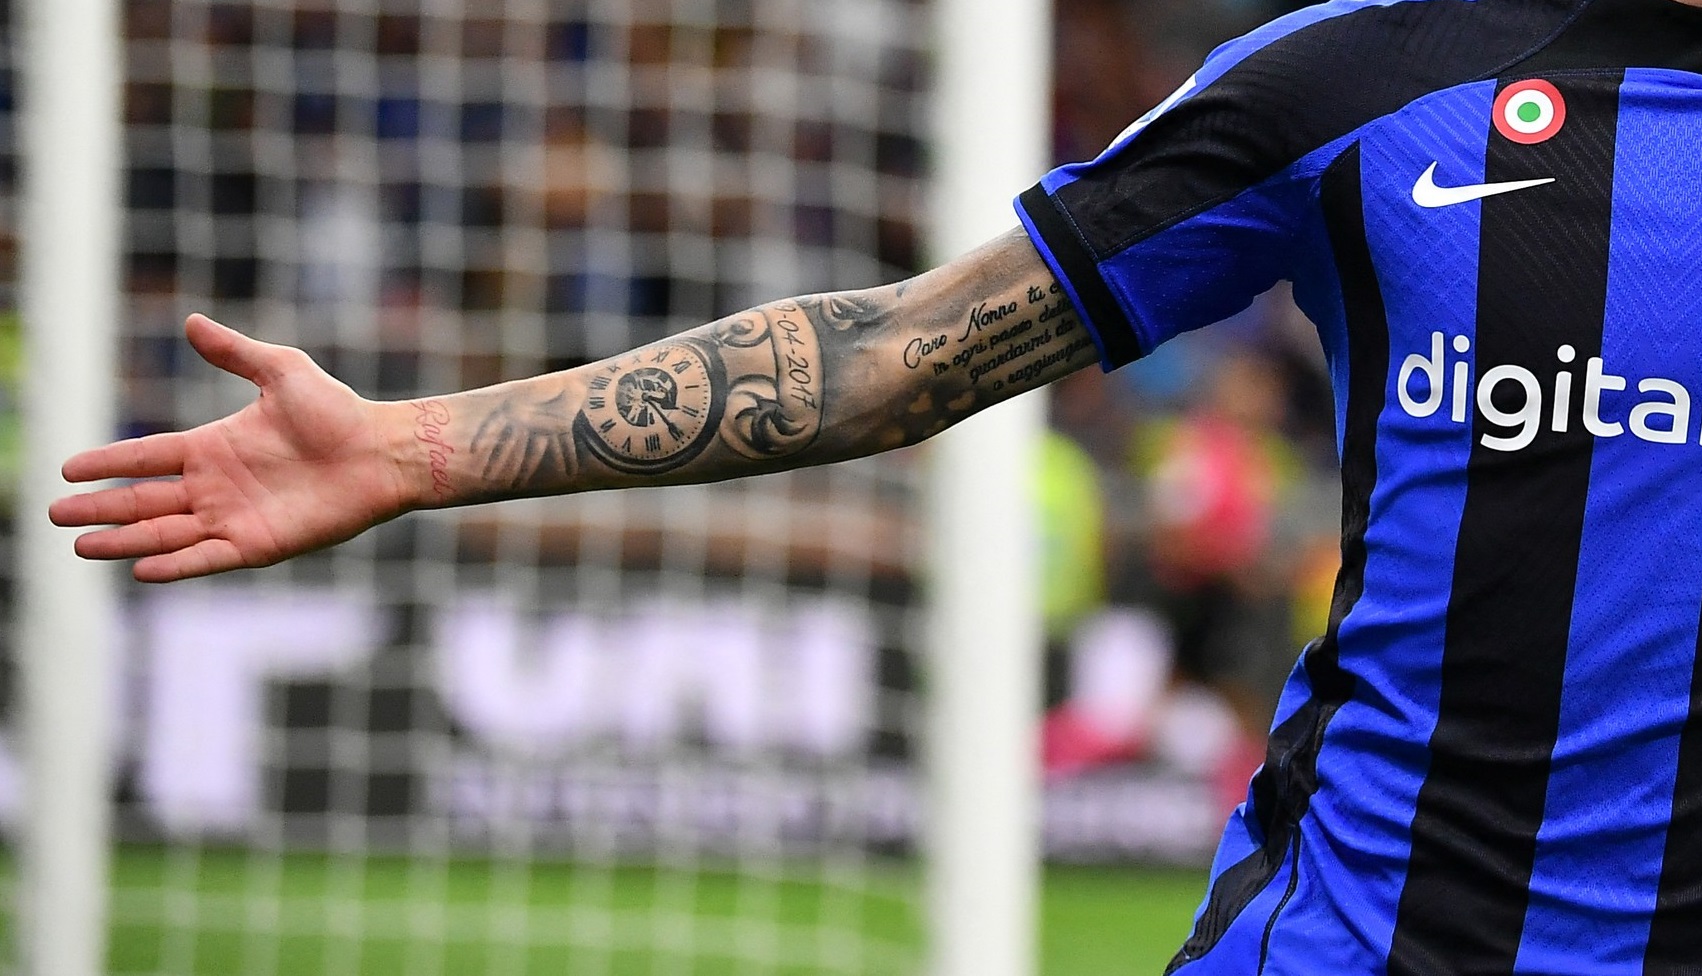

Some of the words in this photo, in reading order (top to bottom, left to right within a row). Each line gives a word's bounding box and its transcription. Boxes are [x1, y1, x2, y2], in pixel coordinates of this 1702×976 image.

[903, 334, 947, 369] Caro
[957, 302, 1018, 342] Nonno
[410, 399, 457, 499] Rafael
